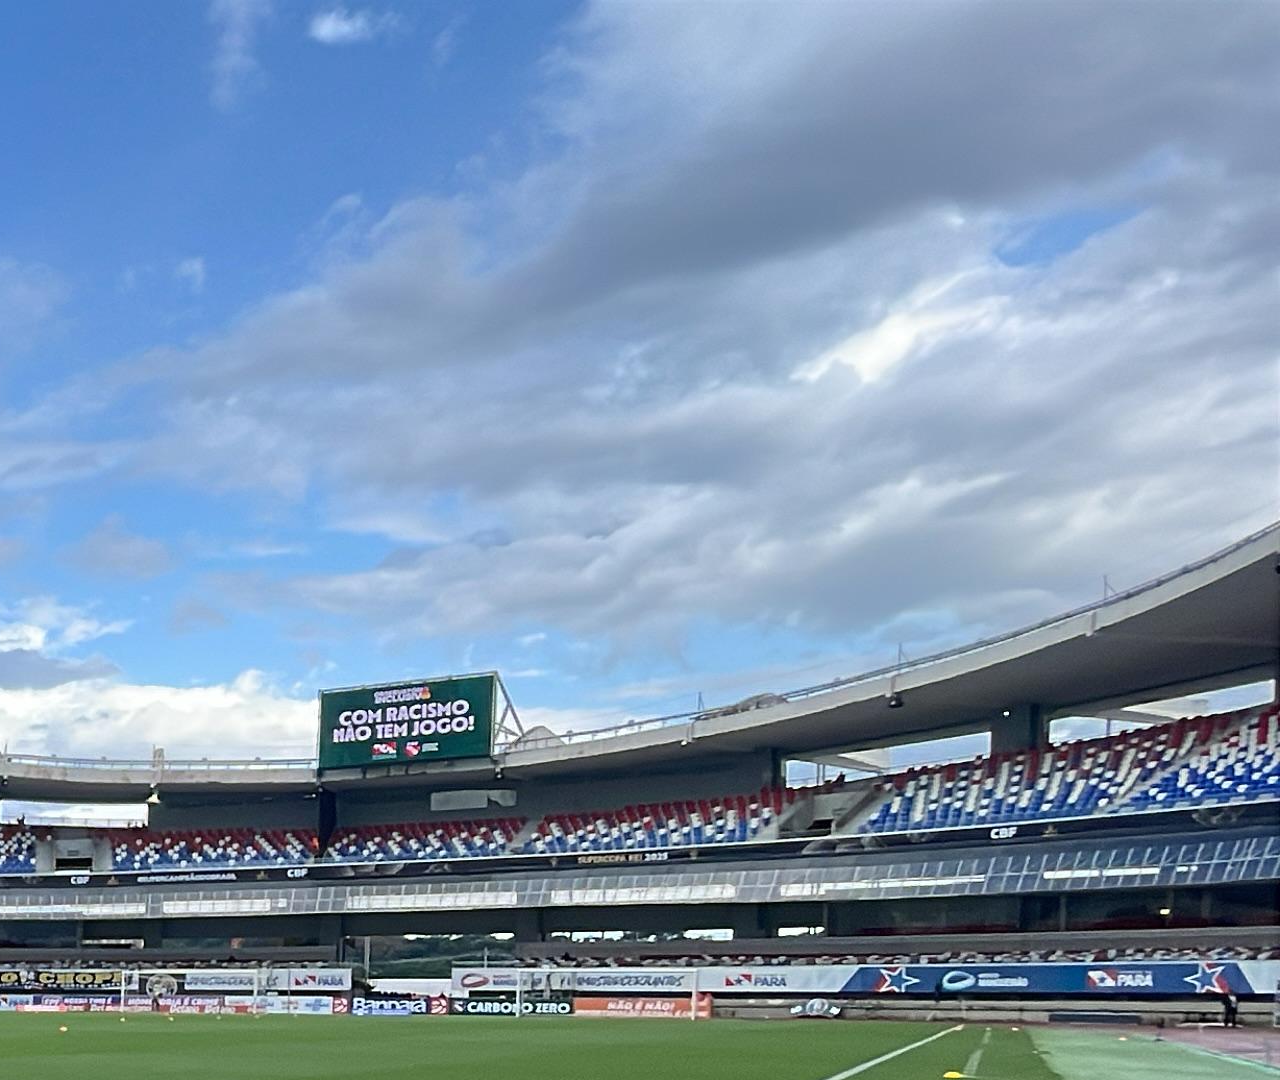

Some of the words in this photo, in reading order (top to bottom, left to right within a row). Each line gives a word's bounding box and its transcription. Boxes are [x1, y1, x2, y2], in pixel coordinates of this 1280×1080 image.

[339, 708, 381, 726] COM
[387, 700, 470, 722] RACISMO
[333, 724, 371, 743] NÃO
[376, 721, 408, 739] TEM
[411, 715, 475, 737] JOGO!
[990, 827, 1018, 840] CBF
[287, 868, 308, 878] CBF
[536, 1001, 571, 1014] ZERO
